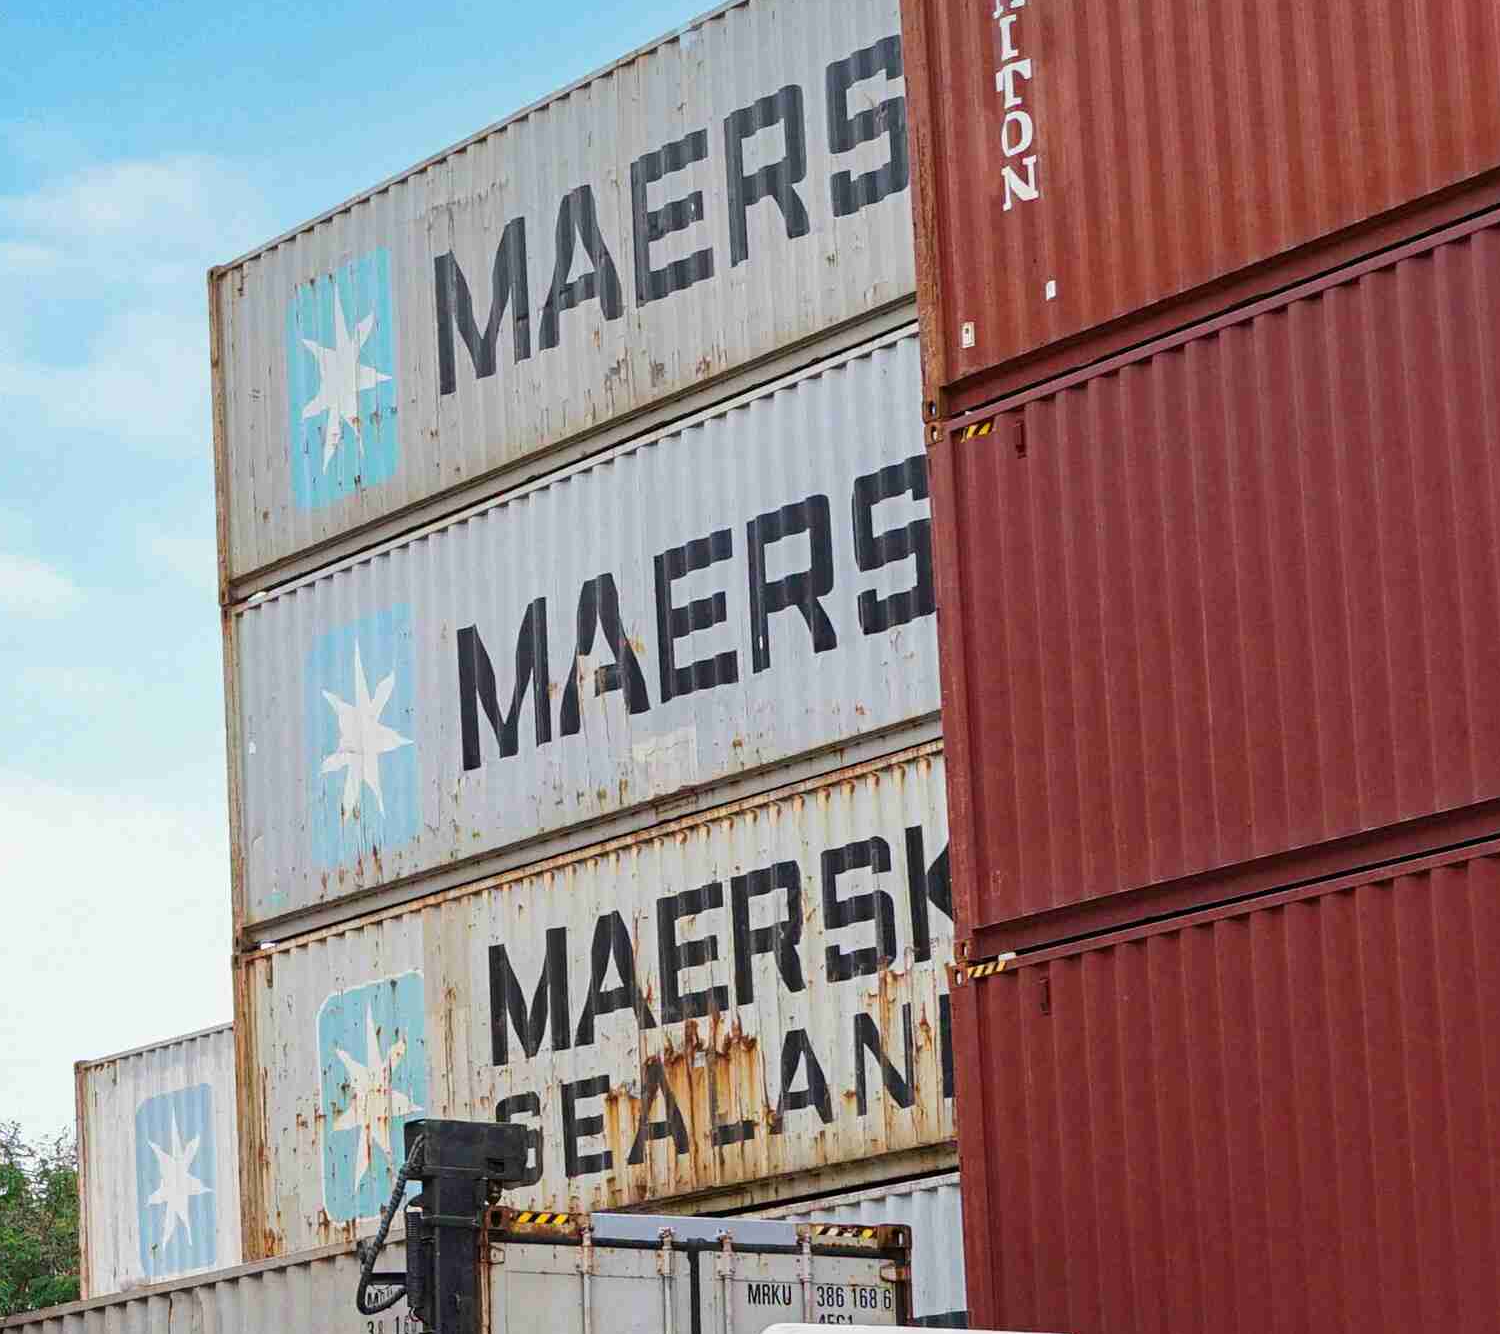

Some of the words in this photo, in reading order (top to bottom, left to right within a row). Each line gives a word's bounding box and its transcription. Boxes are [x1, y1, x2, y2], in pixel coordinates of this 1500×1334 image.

[747, 1283, 792, 1307] MRKU
[816, 1286, 844, 1308] 386
[851, 1287, 878, 1309] 168
[882, 1289, 892, 1310] 6
